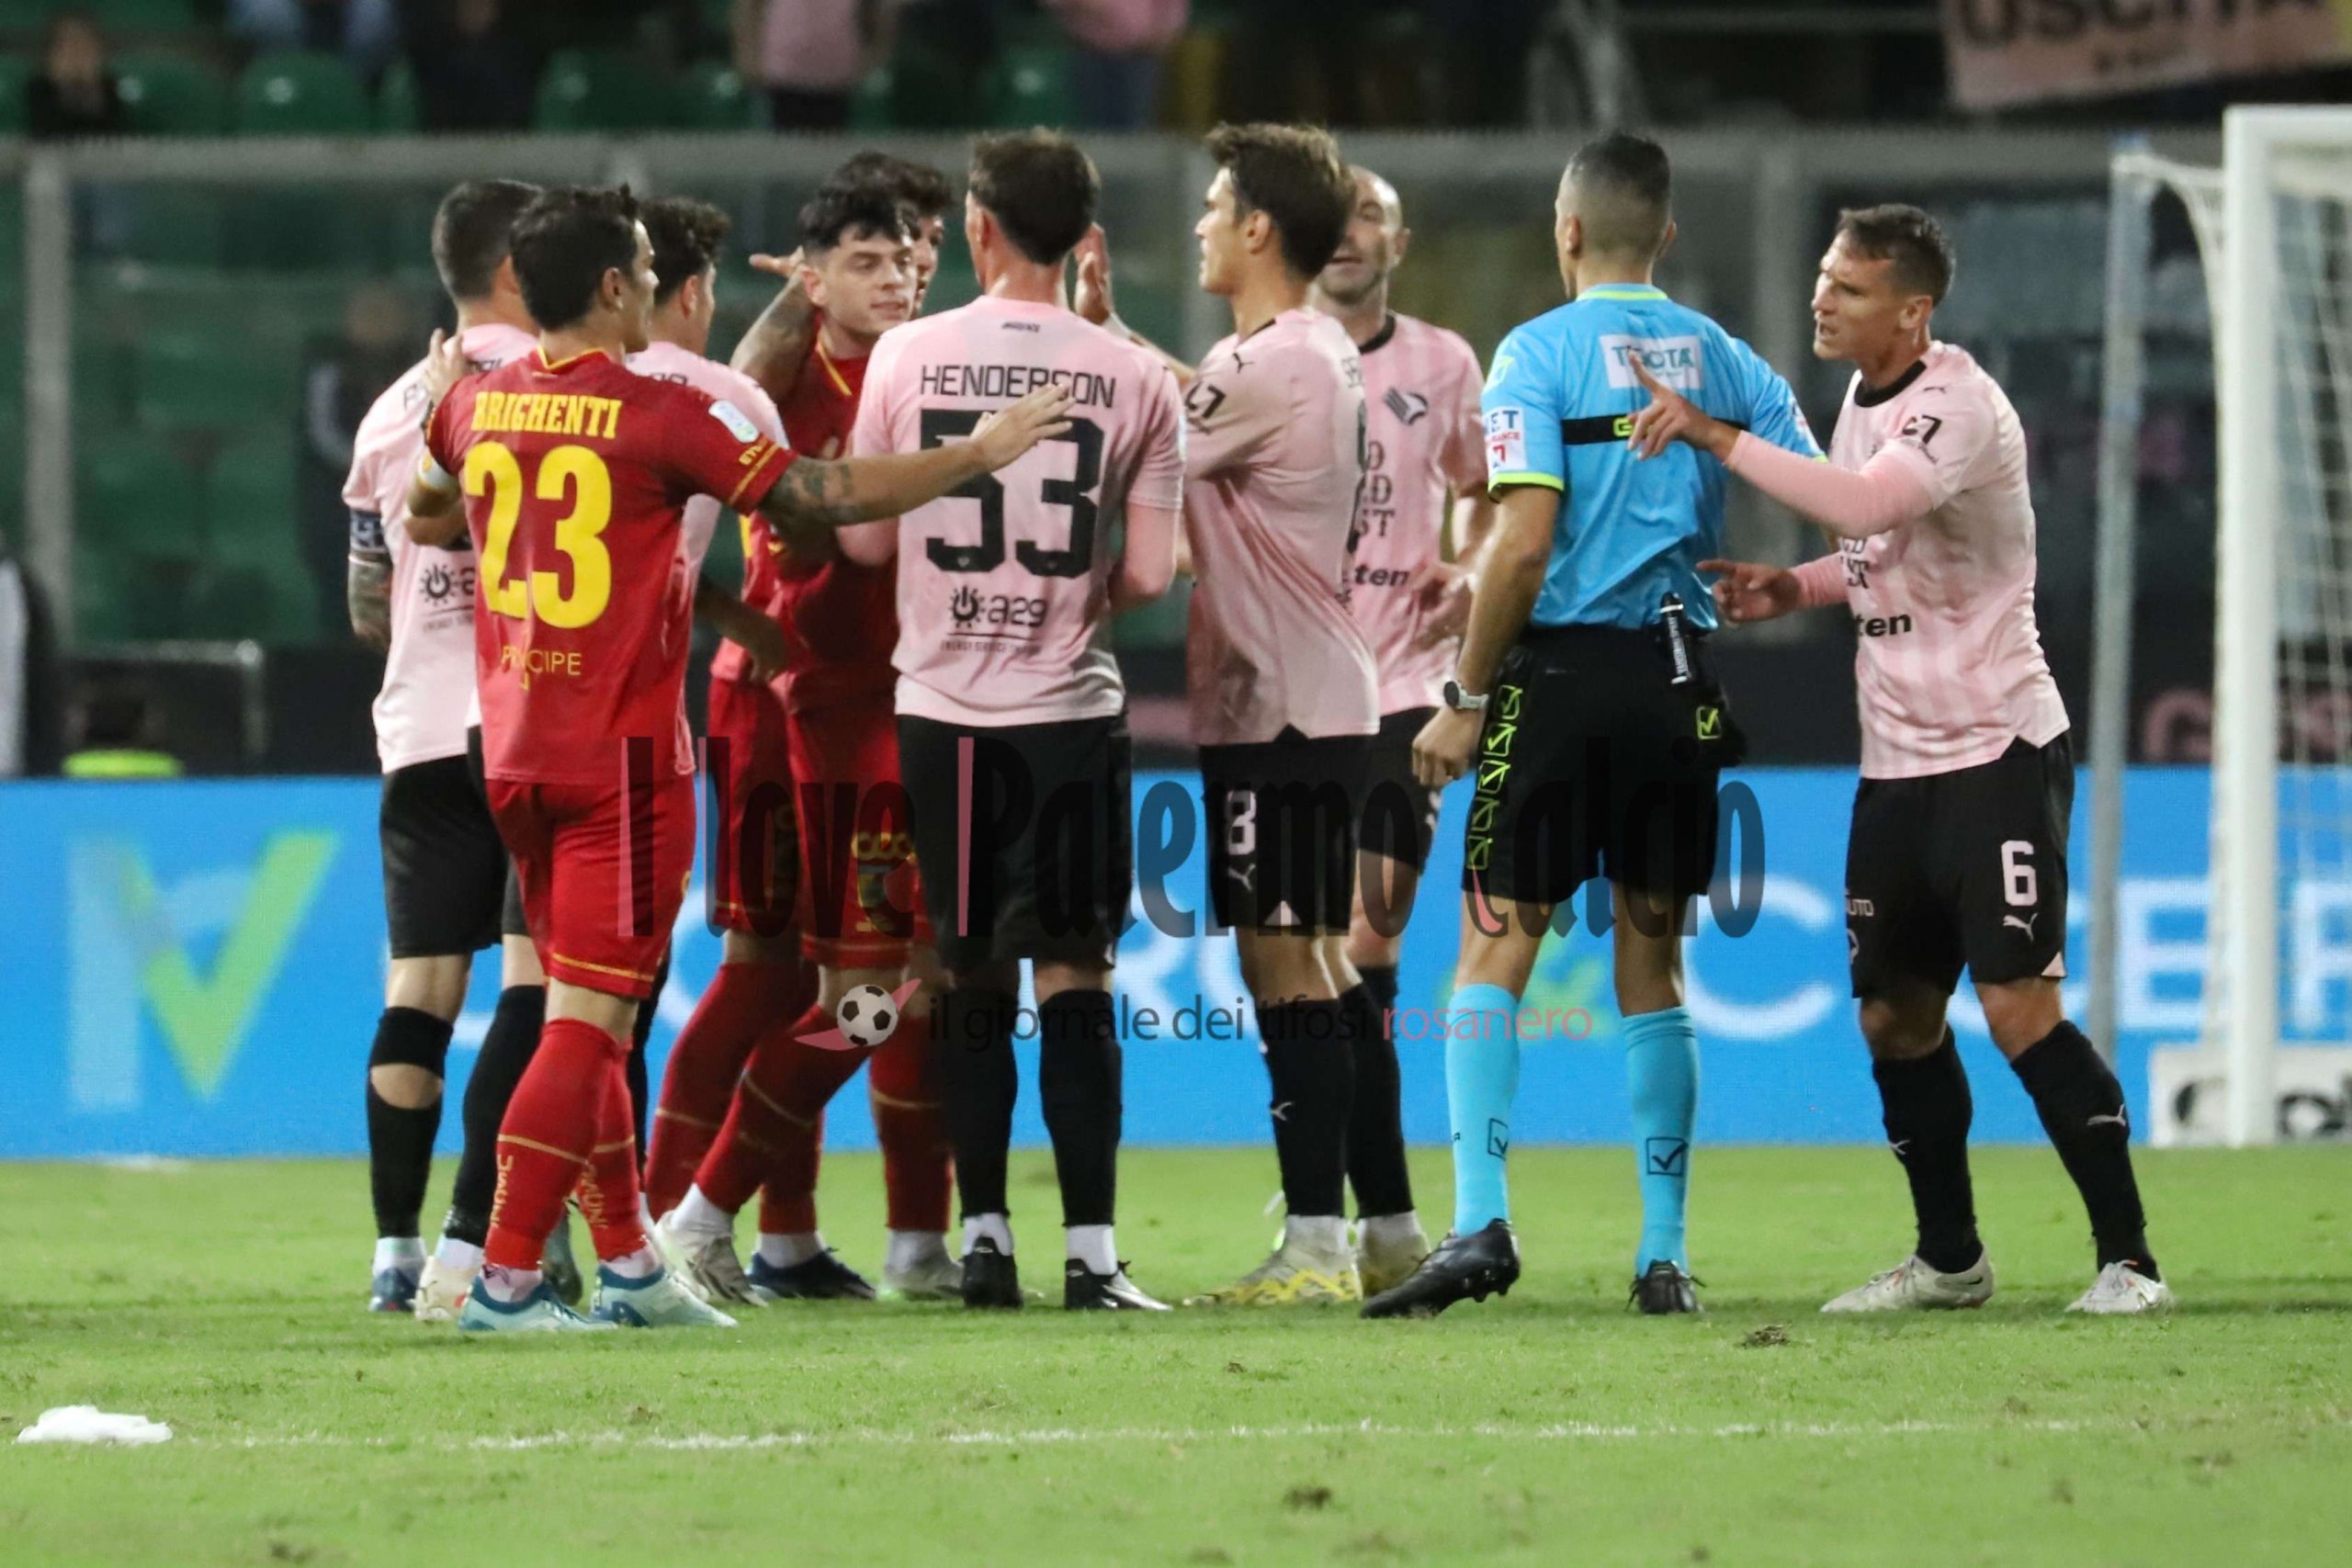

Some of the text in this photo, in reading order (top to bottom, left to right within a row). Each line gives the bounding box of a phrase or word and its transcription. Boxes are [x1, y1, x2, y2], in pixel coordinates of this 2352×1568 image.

[471, 391, 623, 439] BRIGHENTI
[921, 409, 1104, 579] 53
[463, 440, 613, 628] 23
[1354, 562, 1410, 588] ten
[988, 595, 1048, 627] a29
[1857, 613, 1912, 637] ten
[1226, 789, 1257, 855] 8
[2001, 840, 2038, 907] 6
